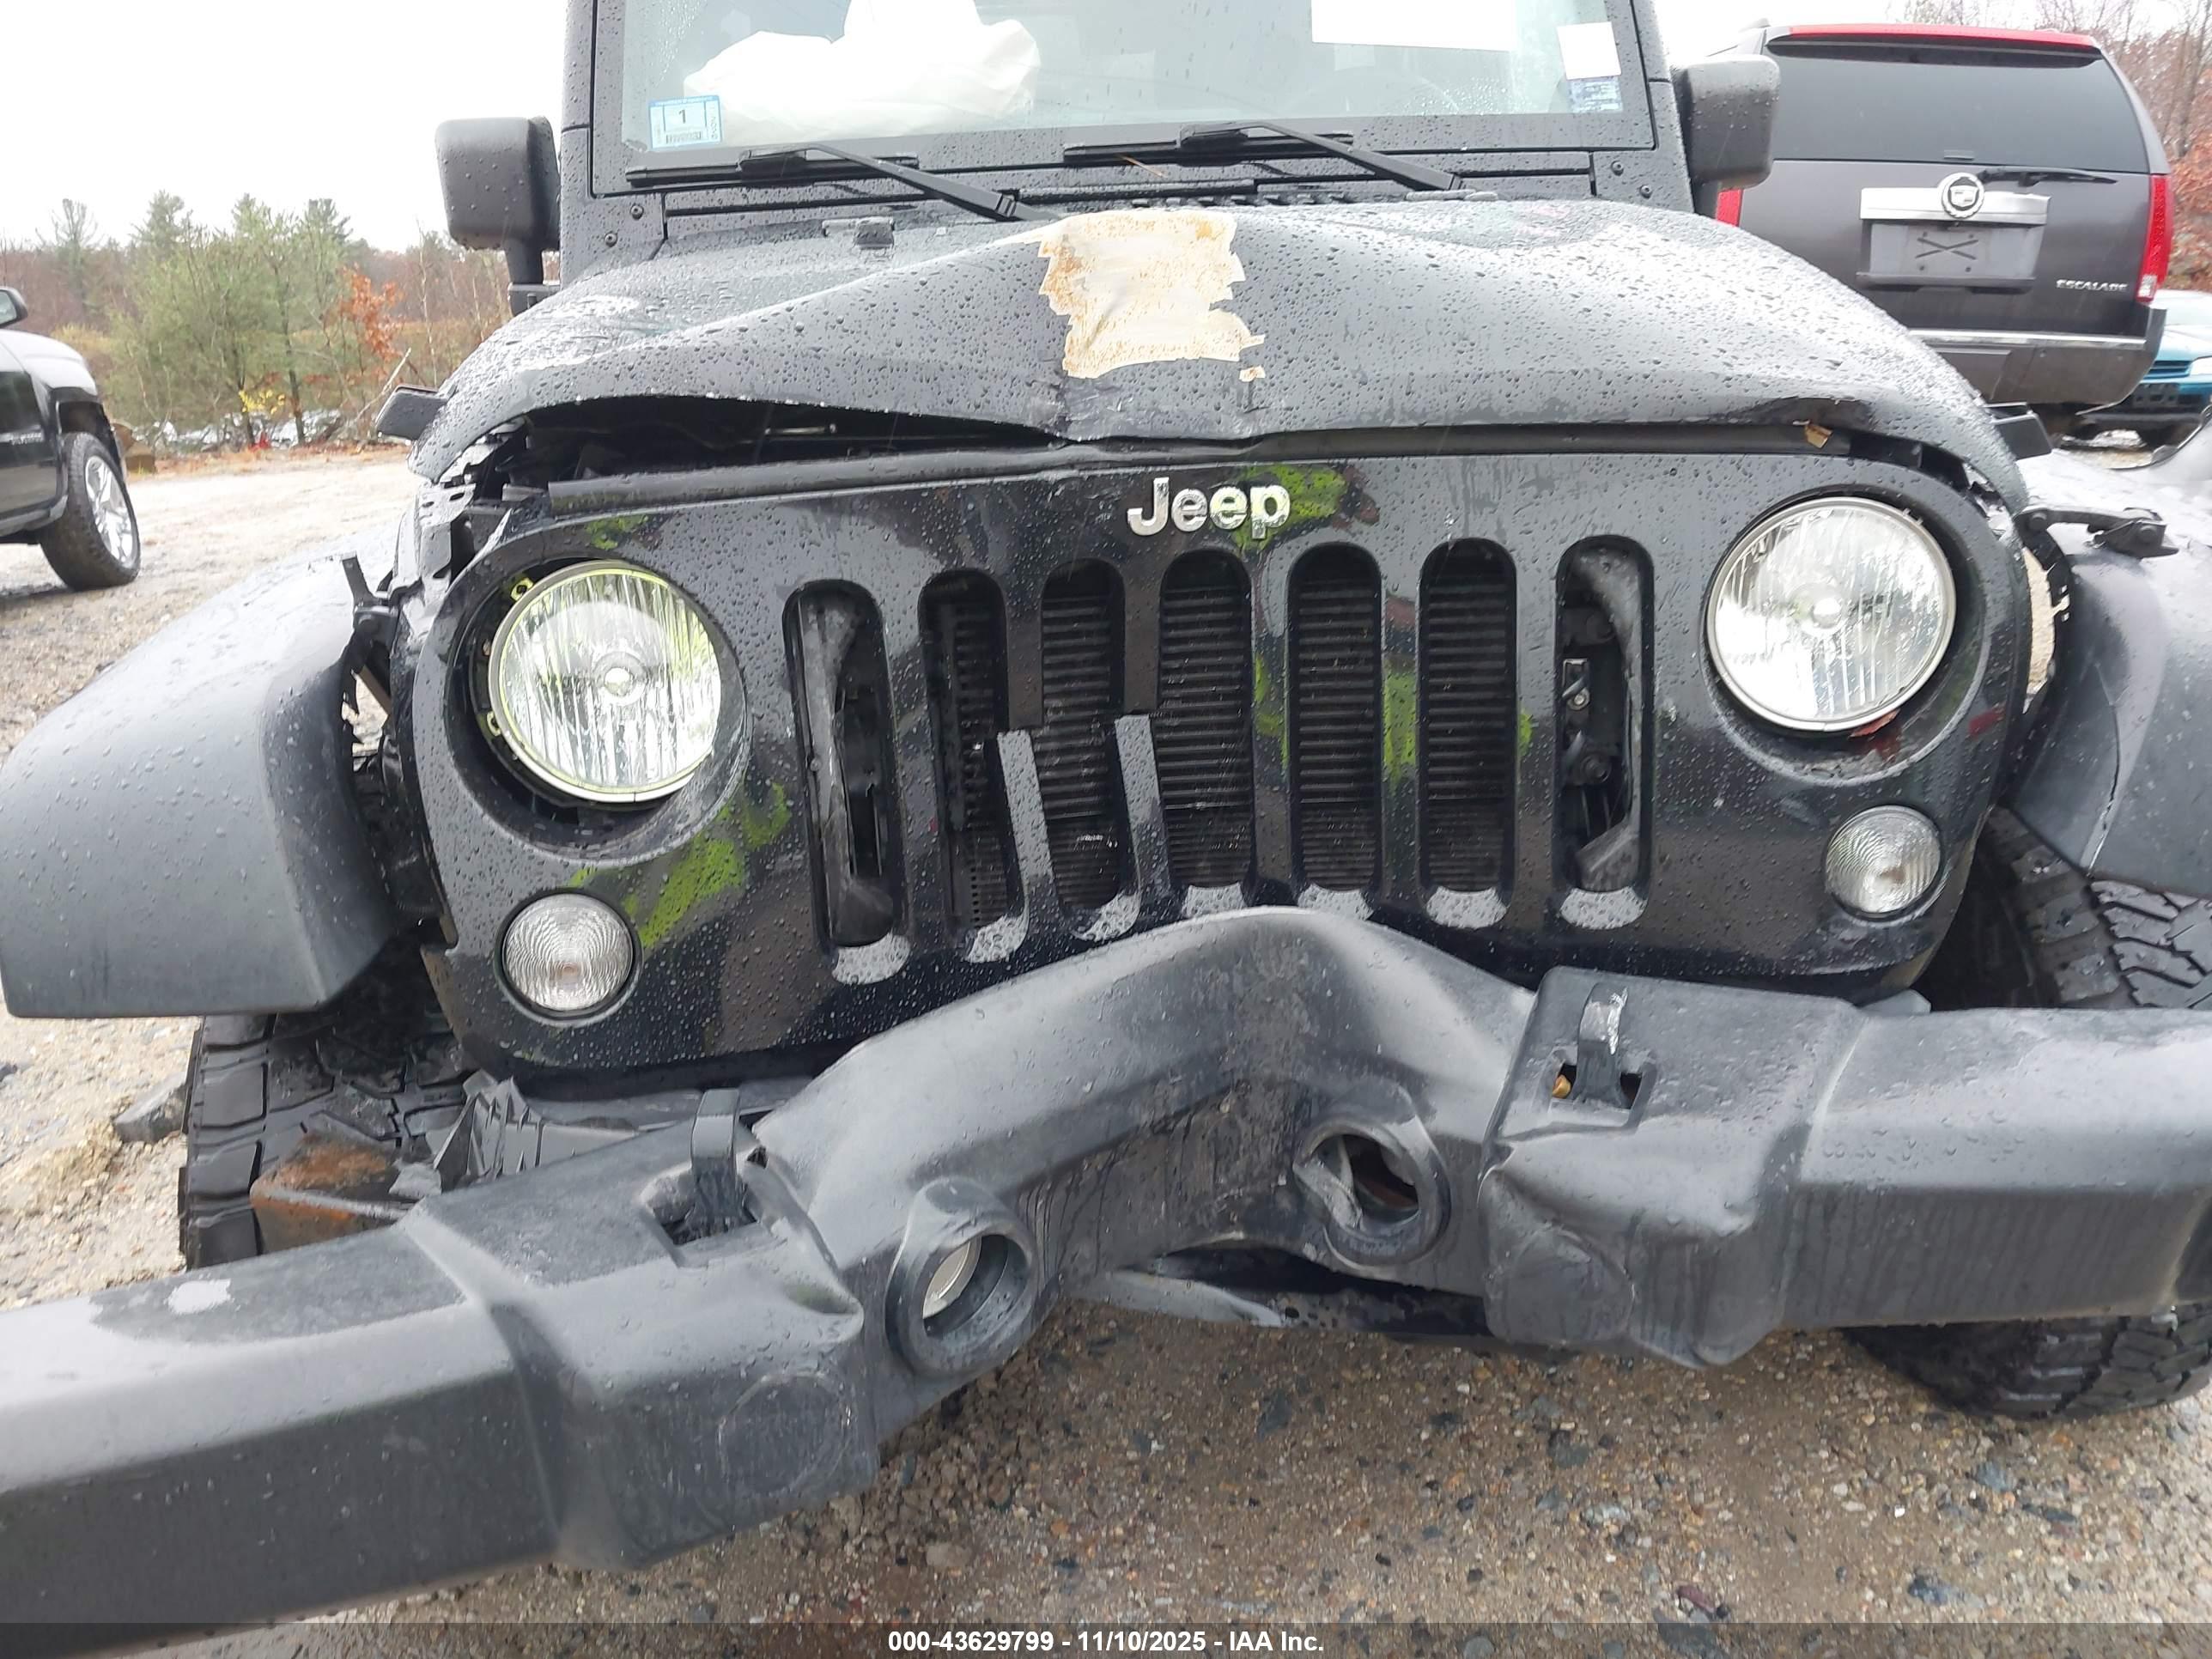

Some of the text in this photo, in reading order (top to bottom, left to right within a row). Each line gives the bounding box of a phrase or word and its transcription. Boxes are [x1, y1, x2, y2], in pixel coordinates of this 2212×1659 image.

[678, 109, 686, 125] 1
[2056, 279, 2129, 292] ESCALADE
[1127, 477, 1291, 540] Jeep
